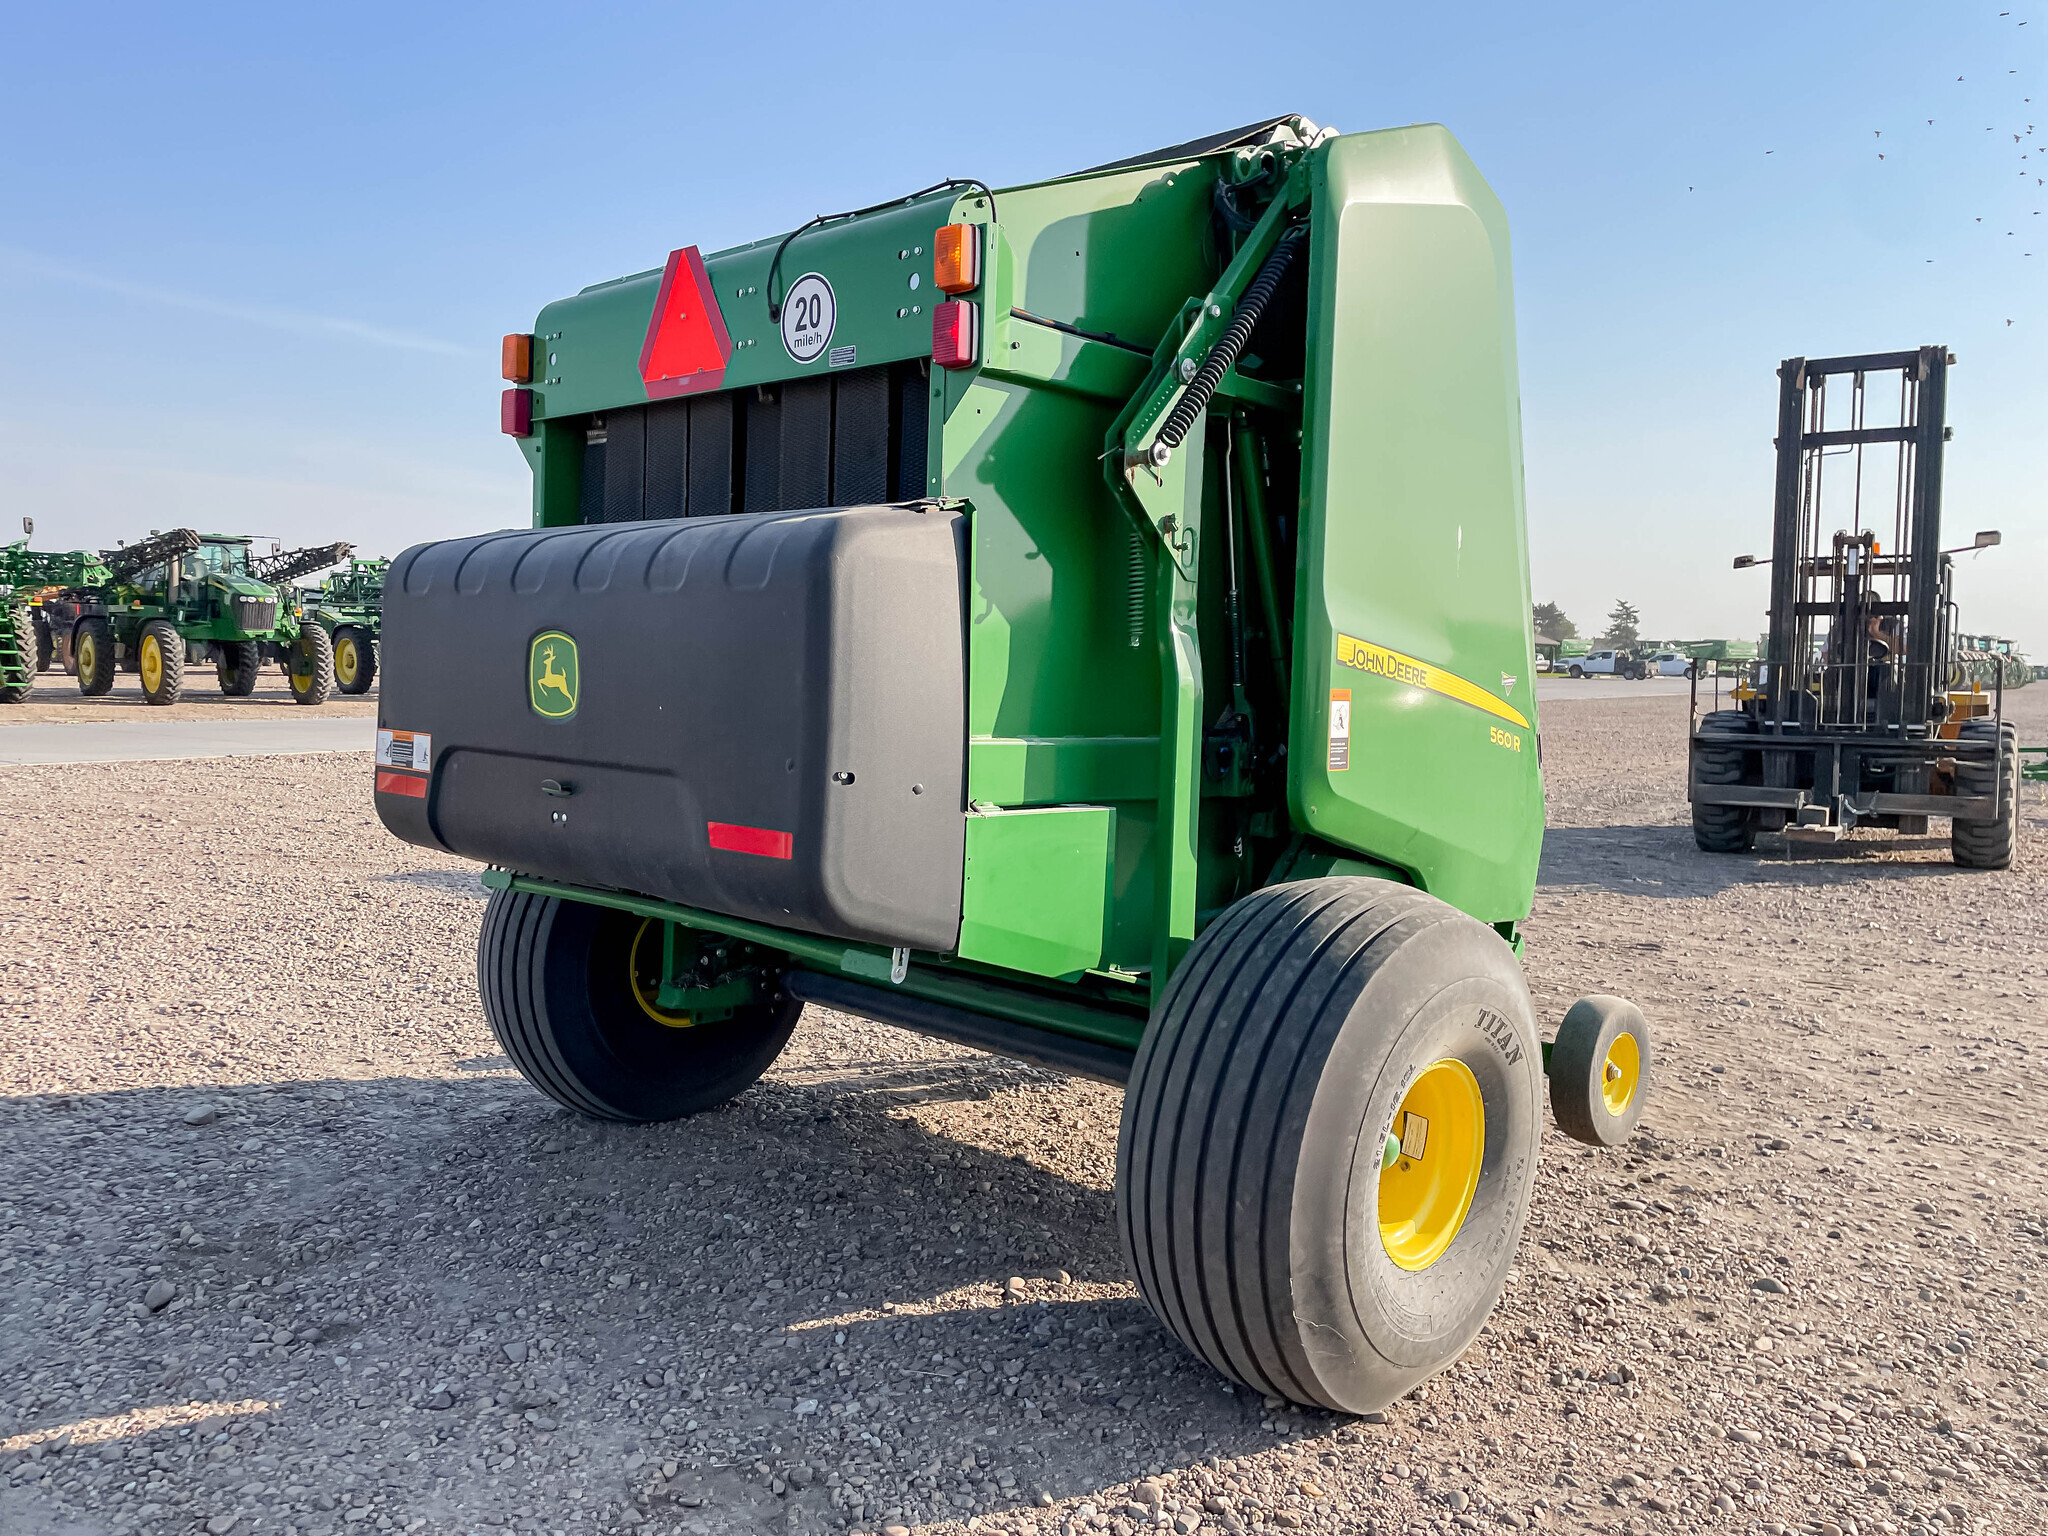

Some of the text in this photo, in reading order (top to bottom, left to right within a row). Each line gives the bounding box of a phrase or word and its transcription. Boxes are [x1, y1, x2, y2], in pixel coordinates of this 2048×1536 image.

[795, 293, 821, 332] 20
[794, 332, 822, 348] mile/h
[1348, 643, 1428, 687] JOHN DEERE
[1474, 1008, 1524, 1066] TITAN
